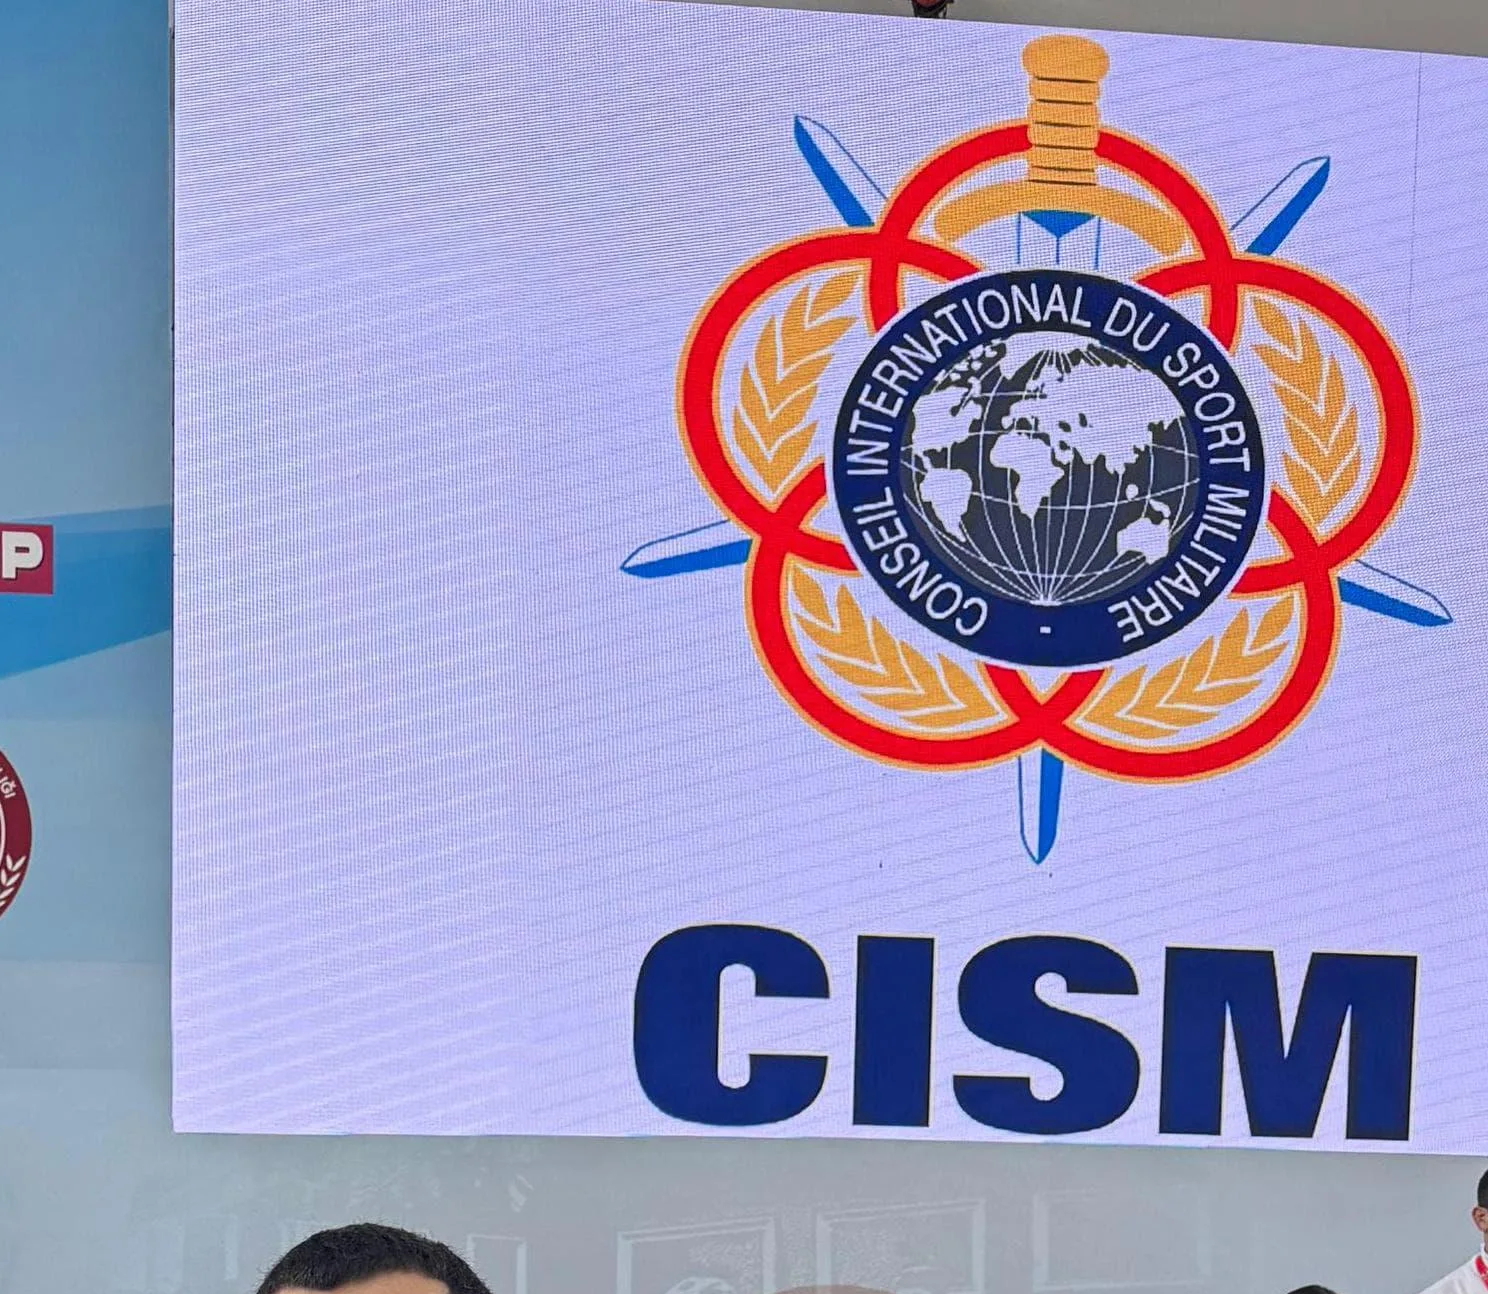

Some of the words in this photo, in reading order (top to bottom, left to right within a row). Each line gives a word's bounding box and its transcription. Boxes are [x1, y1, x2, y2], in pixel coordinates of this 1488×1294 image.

[846, 283, 1092, 475] INTERNATIONAL
[1104, 297, 1171, 351] DU
[1163, 343, 1251, 473] SPORT
[853, 486, 989, 637] CONSEIL
[1108, 482, 1251, 643] MILITAIRE
[634, 924, 1418, 1141] CISM
